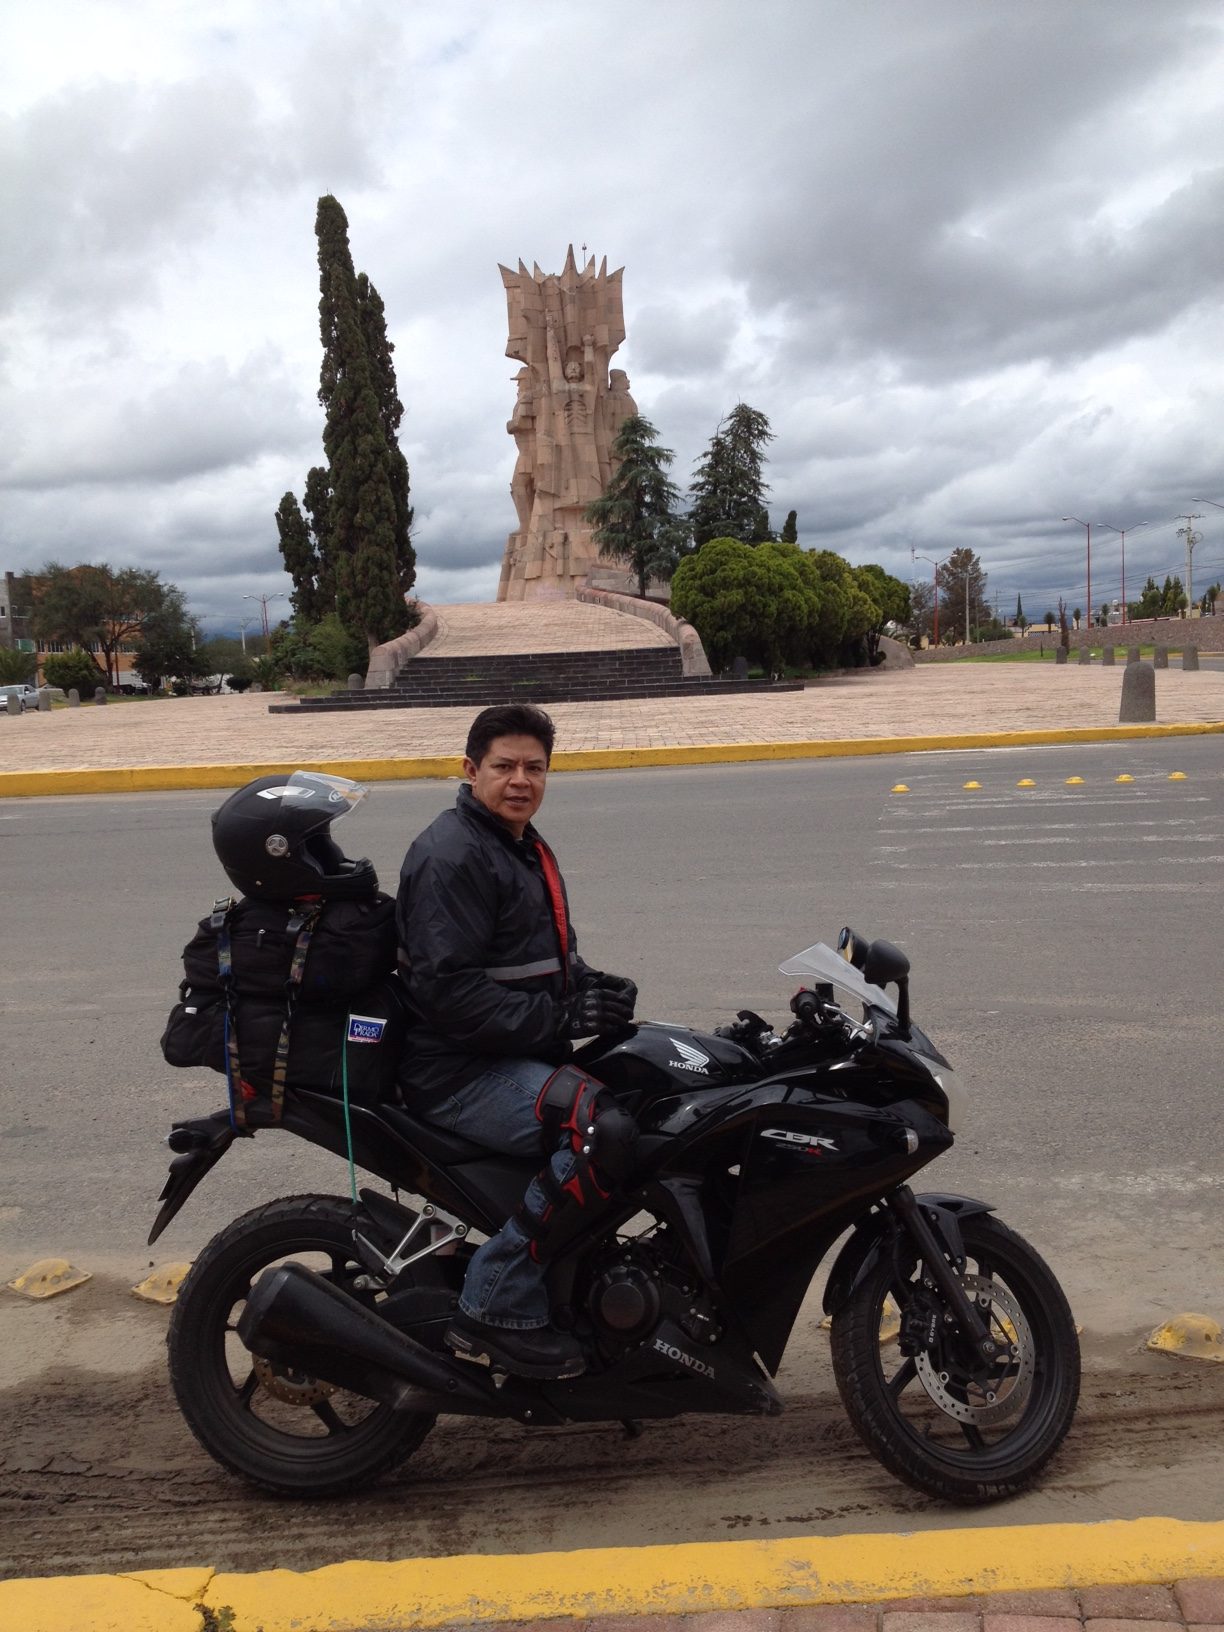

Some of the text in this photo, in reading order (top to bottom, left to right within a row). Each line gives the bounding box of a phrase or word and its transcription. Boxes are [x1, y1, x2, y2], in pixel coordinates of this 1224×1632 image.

[669, 1060, 709, 1075] HONDA
[760, 1128, 839, 1151] CBR
[653, 1338, 716, 1380] HONDA
